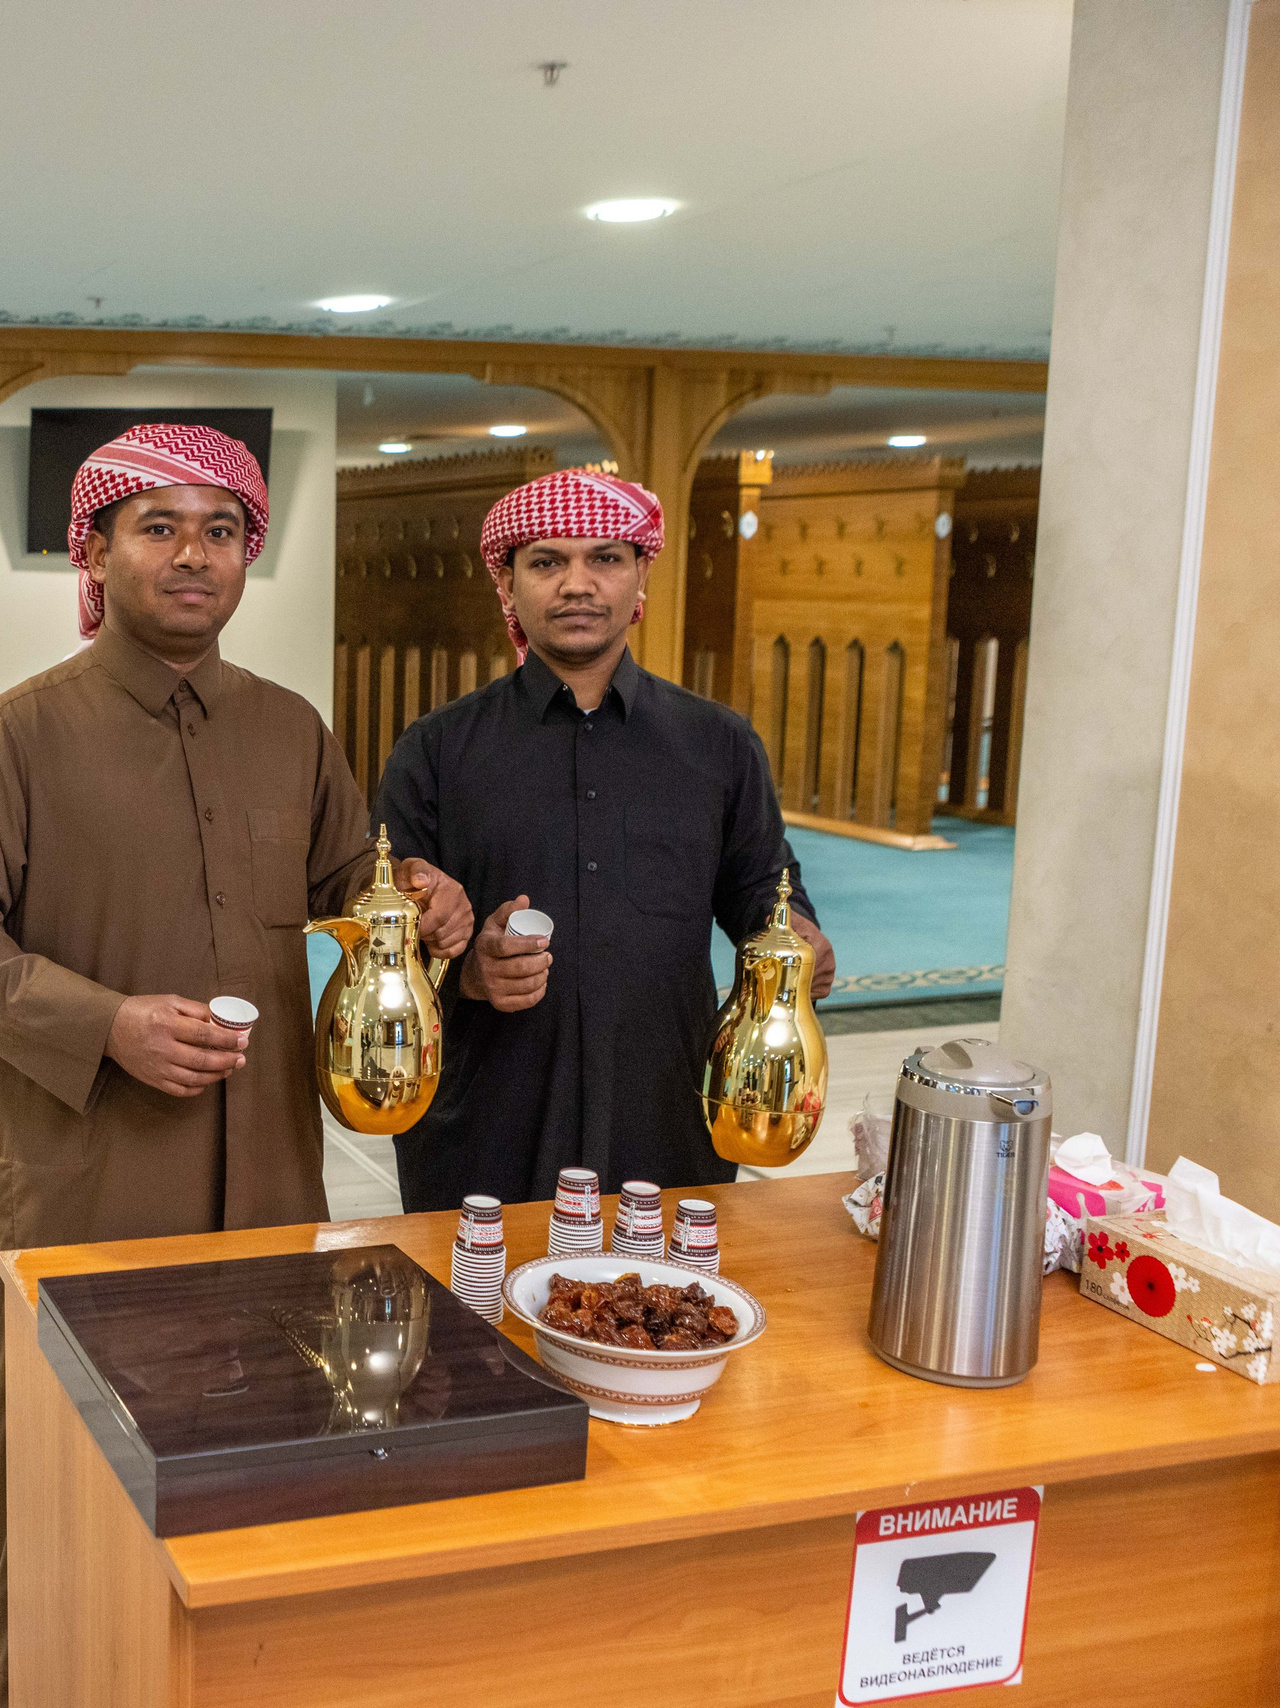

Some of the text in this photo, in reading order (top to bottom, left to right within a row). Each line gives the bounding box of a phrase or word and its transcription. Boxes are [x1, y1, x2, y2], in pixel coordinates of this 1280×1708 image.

[1085, 1279, 1103, 1297] 180
[879, 1497, 1019, 1536] ВНИМАНИЕ
[902, 1645, 966, 1666] ВЕДЁТСЯ
[859, 1655, 1004, 1689] ВИДЕОНАБЛЮДЕНИЕ
